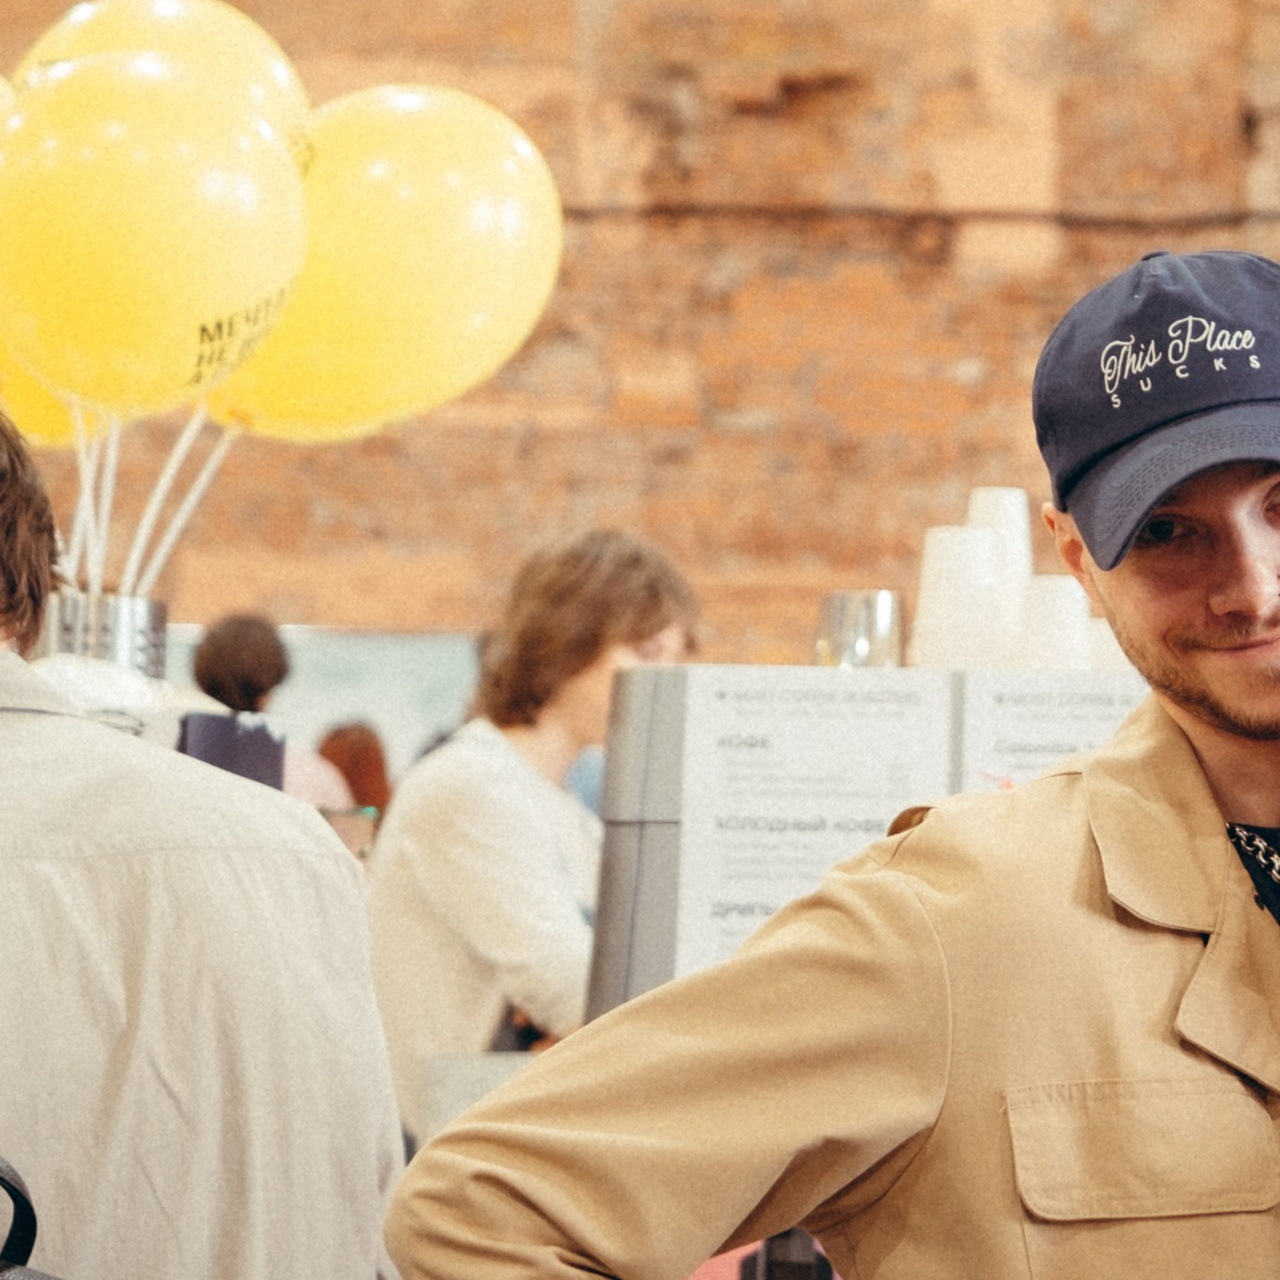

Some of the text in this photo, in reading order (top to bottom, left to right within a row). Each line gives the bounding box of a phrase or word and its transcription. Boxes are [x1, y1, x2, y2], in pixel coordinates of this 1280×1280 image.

[1101, 315, 1256, 394] This Place
[1111, 354, 1261, 408] SUCKS
